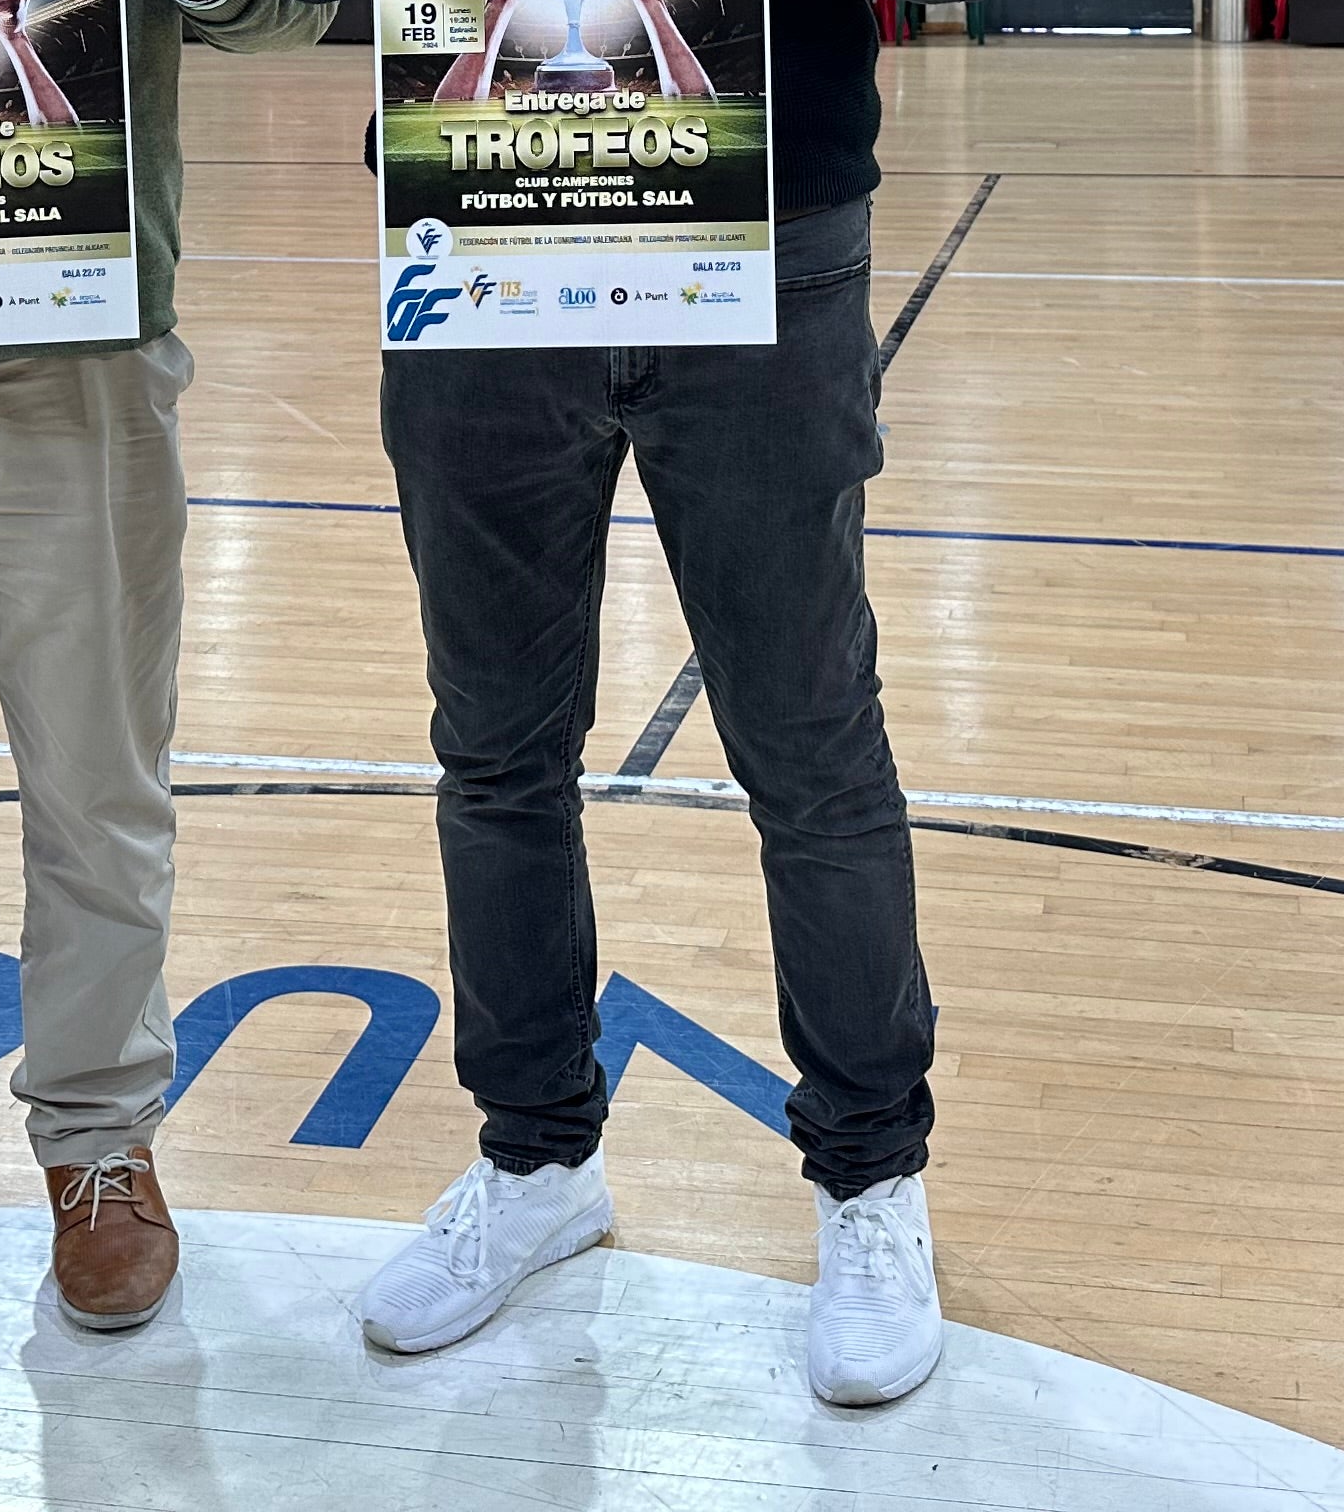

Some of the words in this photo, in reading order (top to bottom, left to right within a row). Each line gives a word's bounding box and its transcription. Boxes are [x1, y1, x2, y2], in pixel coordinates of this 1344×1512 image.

[404, 3, 437, 25] 19
[402, 27, 435, 41] FEB
[505, 89, 606, 115] Entrega
[612, 88, 646, 110] de
[440, 115, 708, 171] TROFEOS
[515, 176, 549, 188] CLUB
[552, 175, 634, 187] CAMPEONES
[461, 190, 538, 209] FÚTBOL
[542, 192, 557, 208] Y
[561, 189, 638, 208] FÚTBOL
[642, 190, 694, 206] SALA
[14, 207, 62, 223] SALA
[82, 267, 106, 277] 22/23
[693, 262, 713, 271] GALA
[715, 261, 741, 271] 22/23
[499, 281, 521, 297] 113
[645, 290, 668, 300] Punt
[19, 297, 40, 305] Punt
